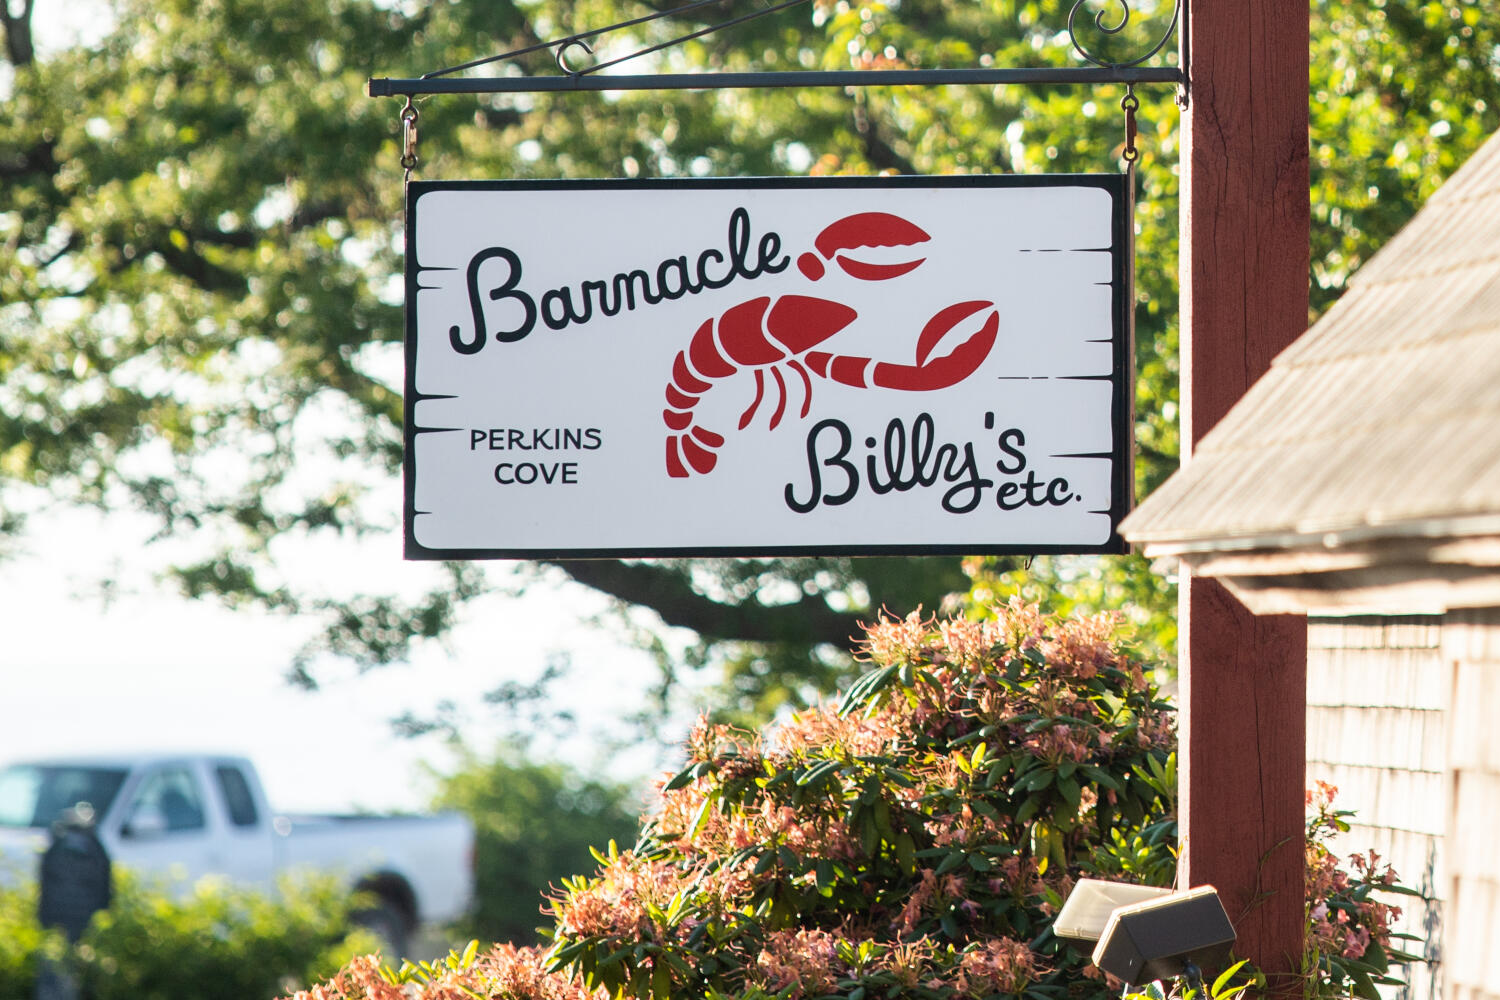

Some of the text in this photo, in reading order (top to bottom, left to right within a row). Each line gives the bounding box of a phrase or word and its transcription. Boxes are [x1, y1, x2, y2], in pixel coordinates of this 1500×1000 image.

[448, 206, 791, 355] Barnacle
[470, 428, 602, 451] PERKINS
[494, 462, 578, 485] COVE
[784, 411, 1027, 514] Billy's
[996, 470, 1082, 511] etc.
